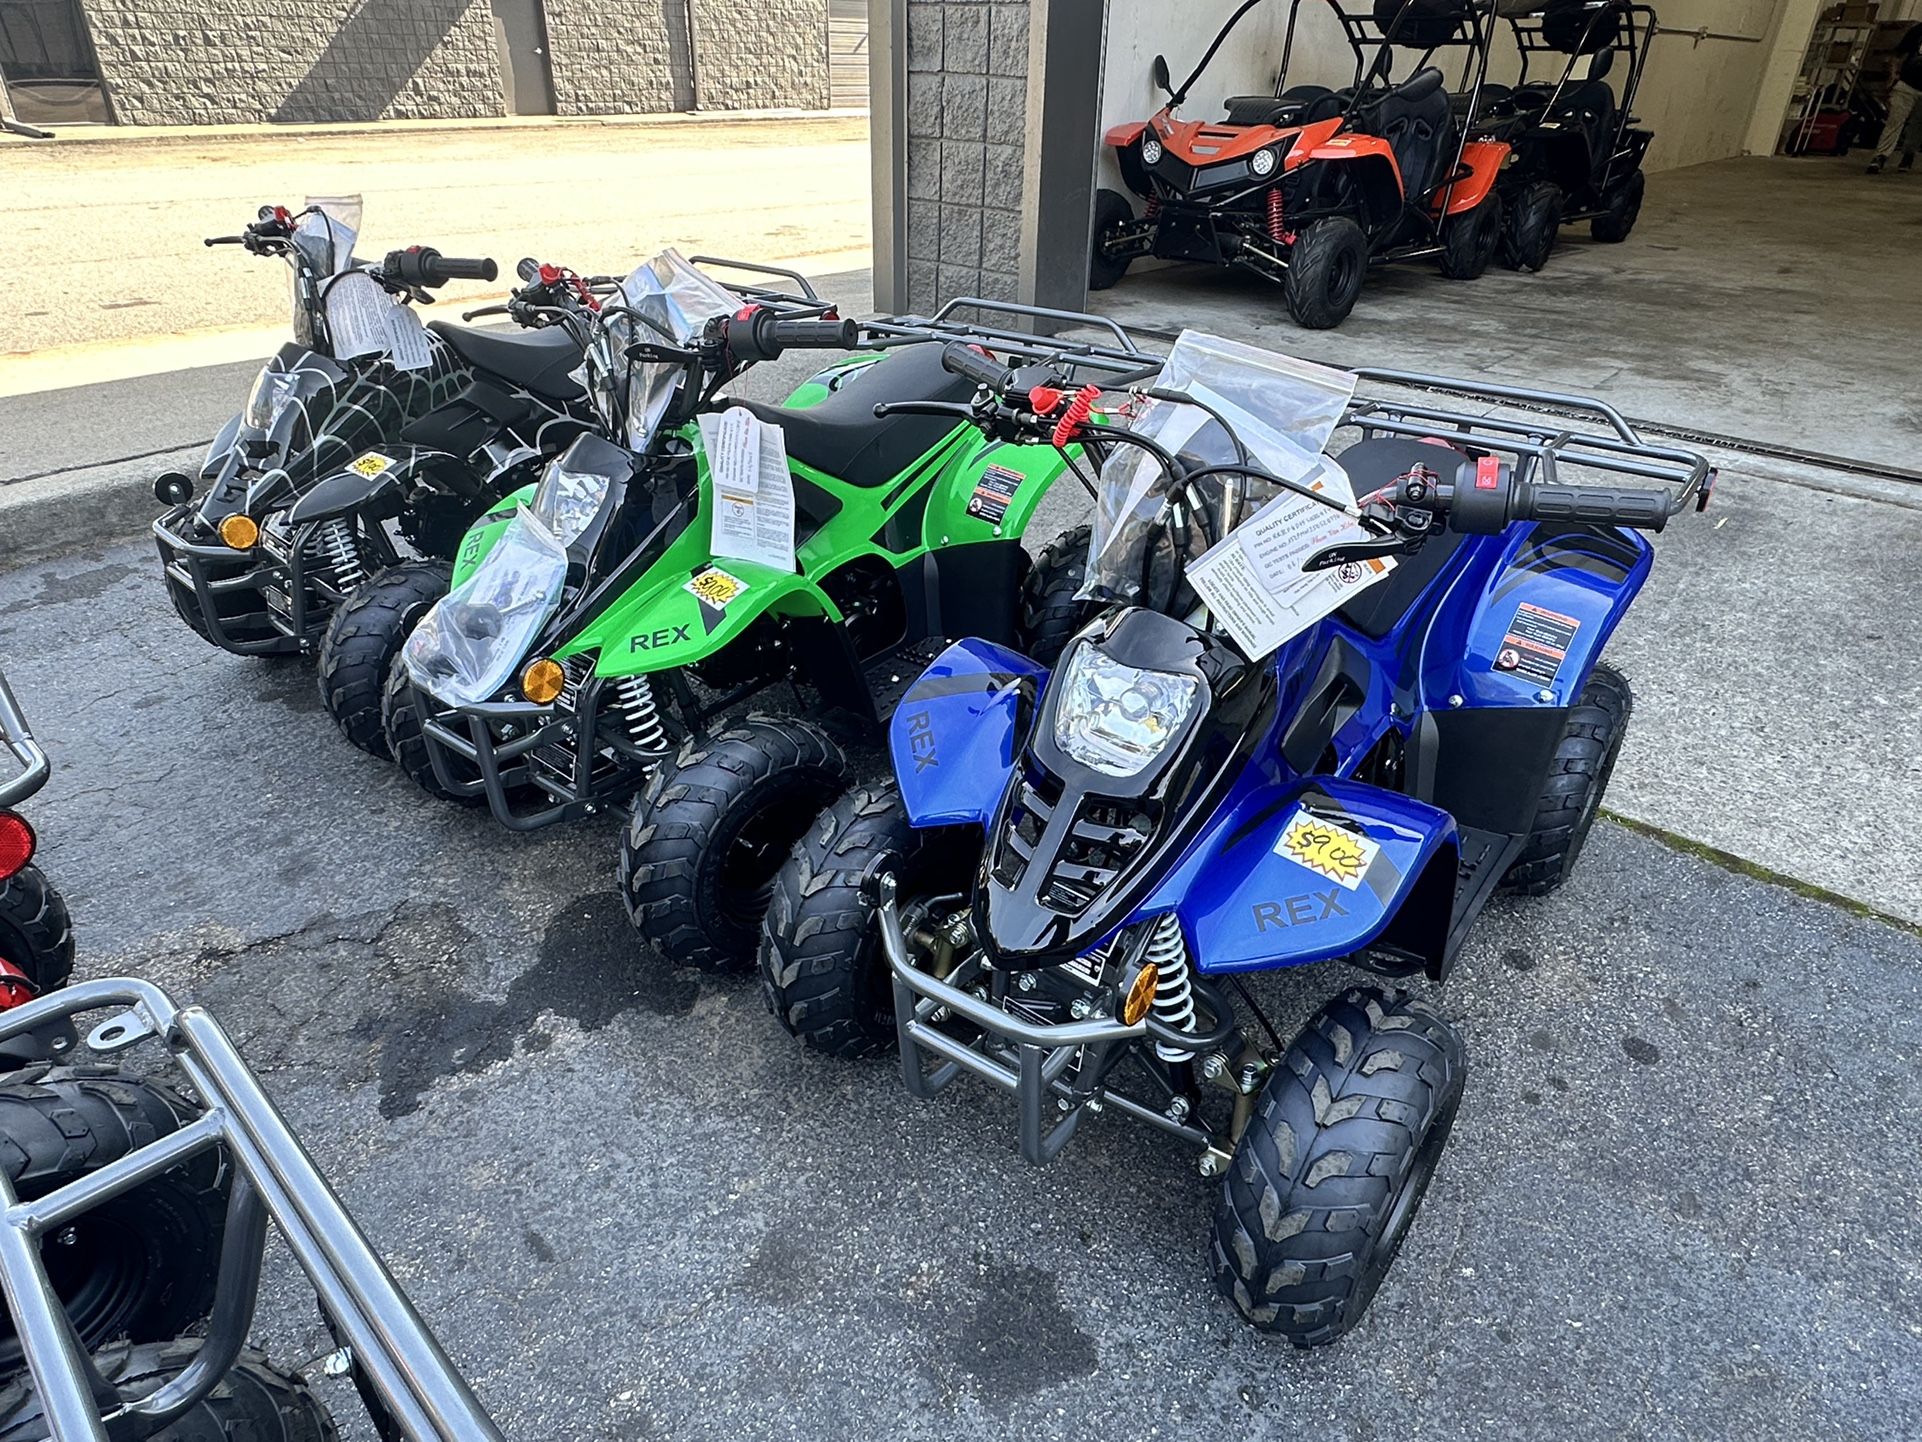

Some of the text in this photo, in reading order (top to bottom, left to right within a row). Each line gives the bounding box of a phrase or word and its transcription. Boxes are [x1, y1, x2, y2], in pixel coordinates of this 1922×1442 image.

[1256, 519, 1282, 536] QUALITY
[460, 531, 485, 572] REX
[630, 623, 691, 653] REX
[906, 711, 938, 774] REX
[1252, 888, 1350, 933] REX
